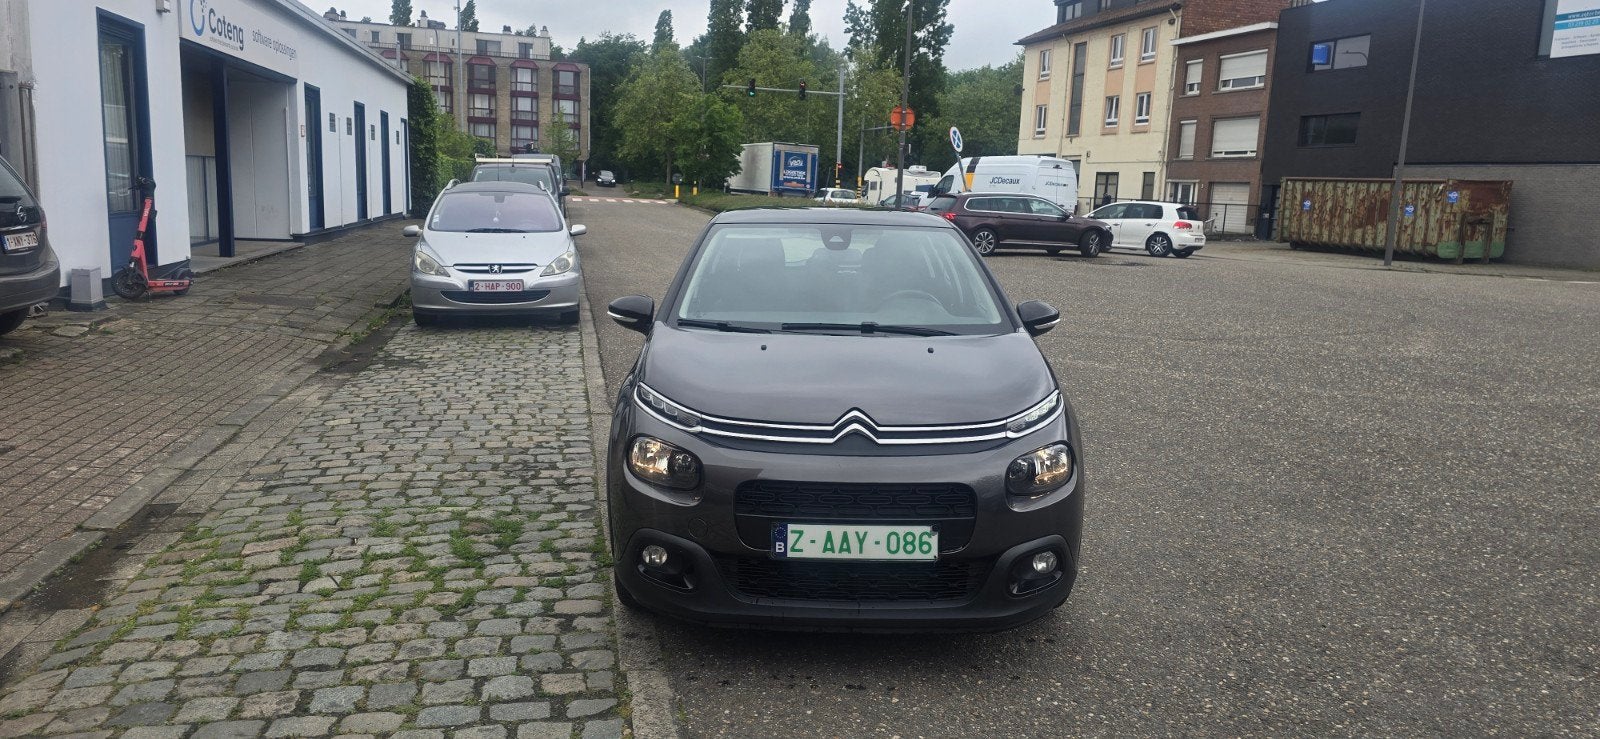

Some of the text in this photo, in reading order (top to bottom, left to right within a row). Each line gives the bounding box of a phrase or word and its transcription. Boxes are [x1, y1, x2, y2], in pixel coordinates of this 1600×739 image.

[208, 8, 244, 51] Coteng
[252, 29, 272, 49] software
[990, 176, 1020, 184] JCDecaux
[474, 282, 521, 291] 2-HAP-900
[775, 529, 933, 555] B Z-AAY-086
